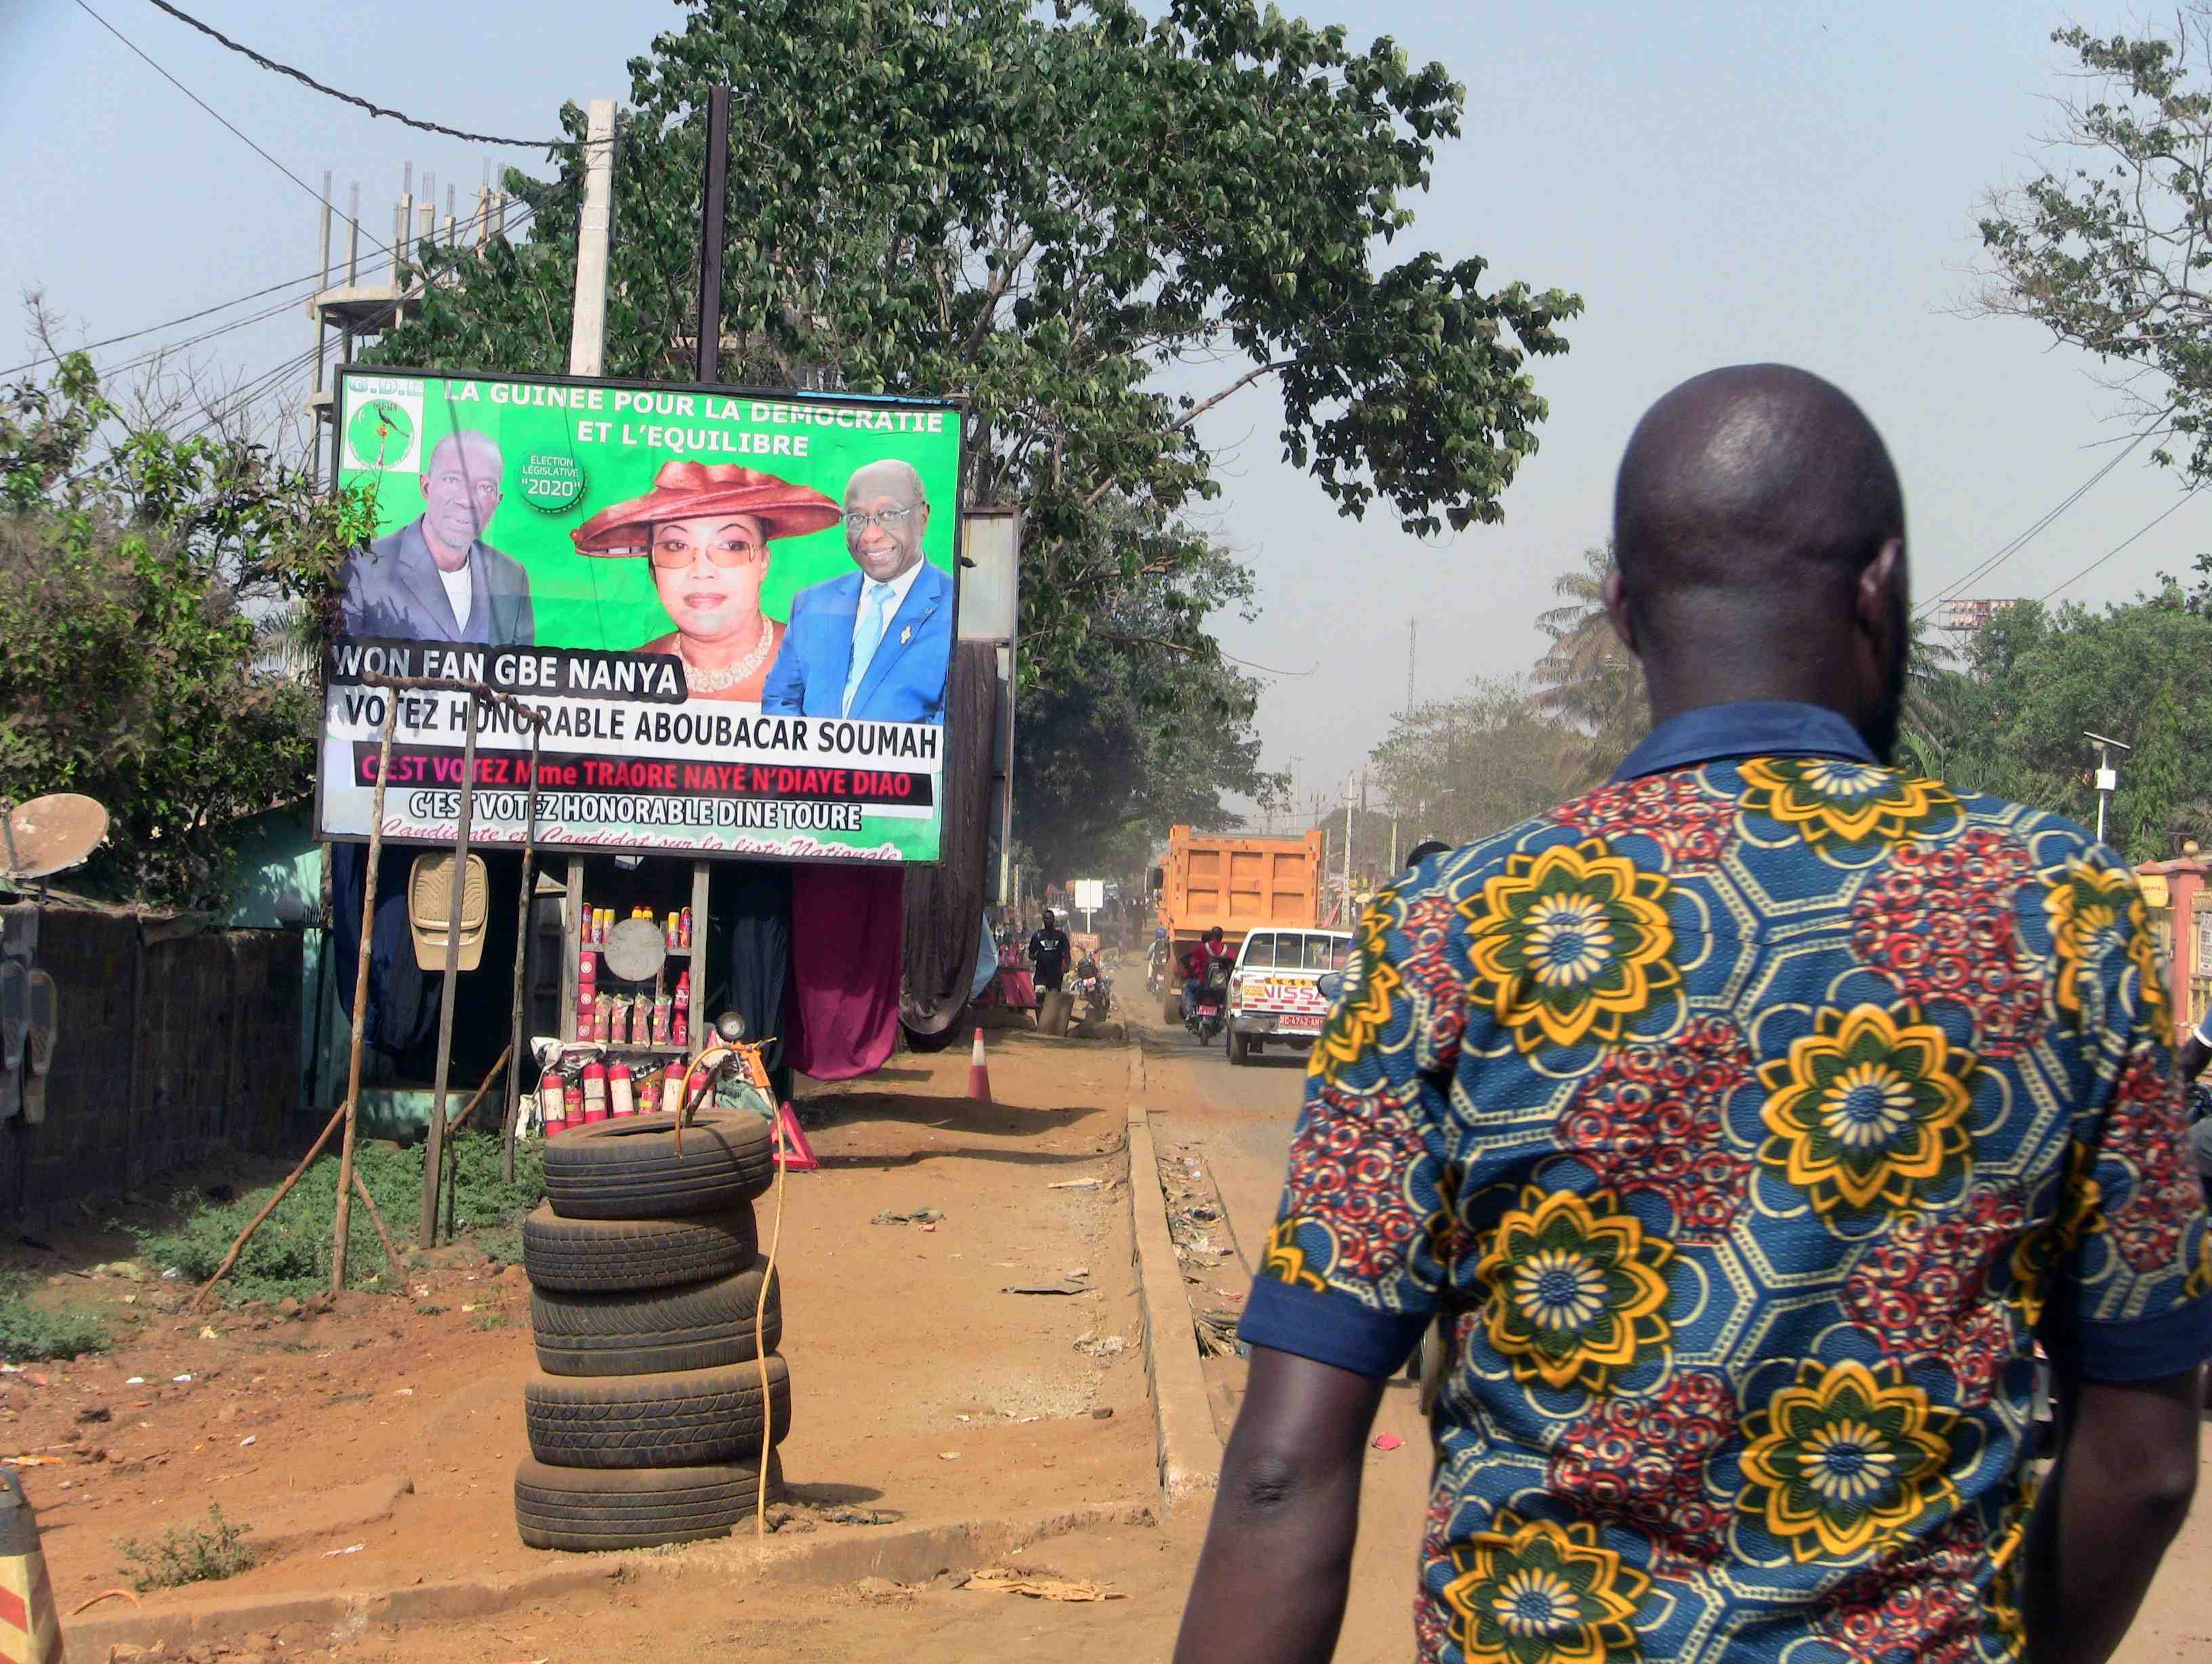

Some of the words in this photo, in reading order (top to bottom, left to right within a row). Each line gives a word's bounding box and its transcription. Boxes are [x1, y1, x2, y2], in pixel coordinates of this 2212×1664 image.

[445, 379, 480, 402] LA
[490, 383, 604, 410] GUINEE
[615, 392, 695, 417] POUR
[705, 398, 740, 421] LA
[750, 403, 944, 433] DEMOCRATIE
[577, 421, 612, 443] ET
[622, 423, 808, 457] L'EQUILIBRE
[523, 465, 579, 477] LÉGISLATIVE
[531, 455, 573, 467] ÉLECTION
[335, 645, 411, 678] WON
[422, 649, 485, 684] FAN
[494, 653, 558, 688] GBE
[569, 658, 678, 695] NANYA
[634, 711, 808, 751] ABOUBACAR
[817, 721, 937, 759] SOUMAH
[514, 758, 578, 785] Mme
[583, 760, 677, 790] TRAORE
[683, 764, 747, 792] NAYÉ
[752, 767, 846, 795] N'DIAYE
[853, 771, 912, 797] DIAO
[561, 794, 713, 826] HONORABLE
[717, 799, 778, 828] DINE
[782, 802, 862, 831] TOURE
[540, 826, 651, 847] Candidat
